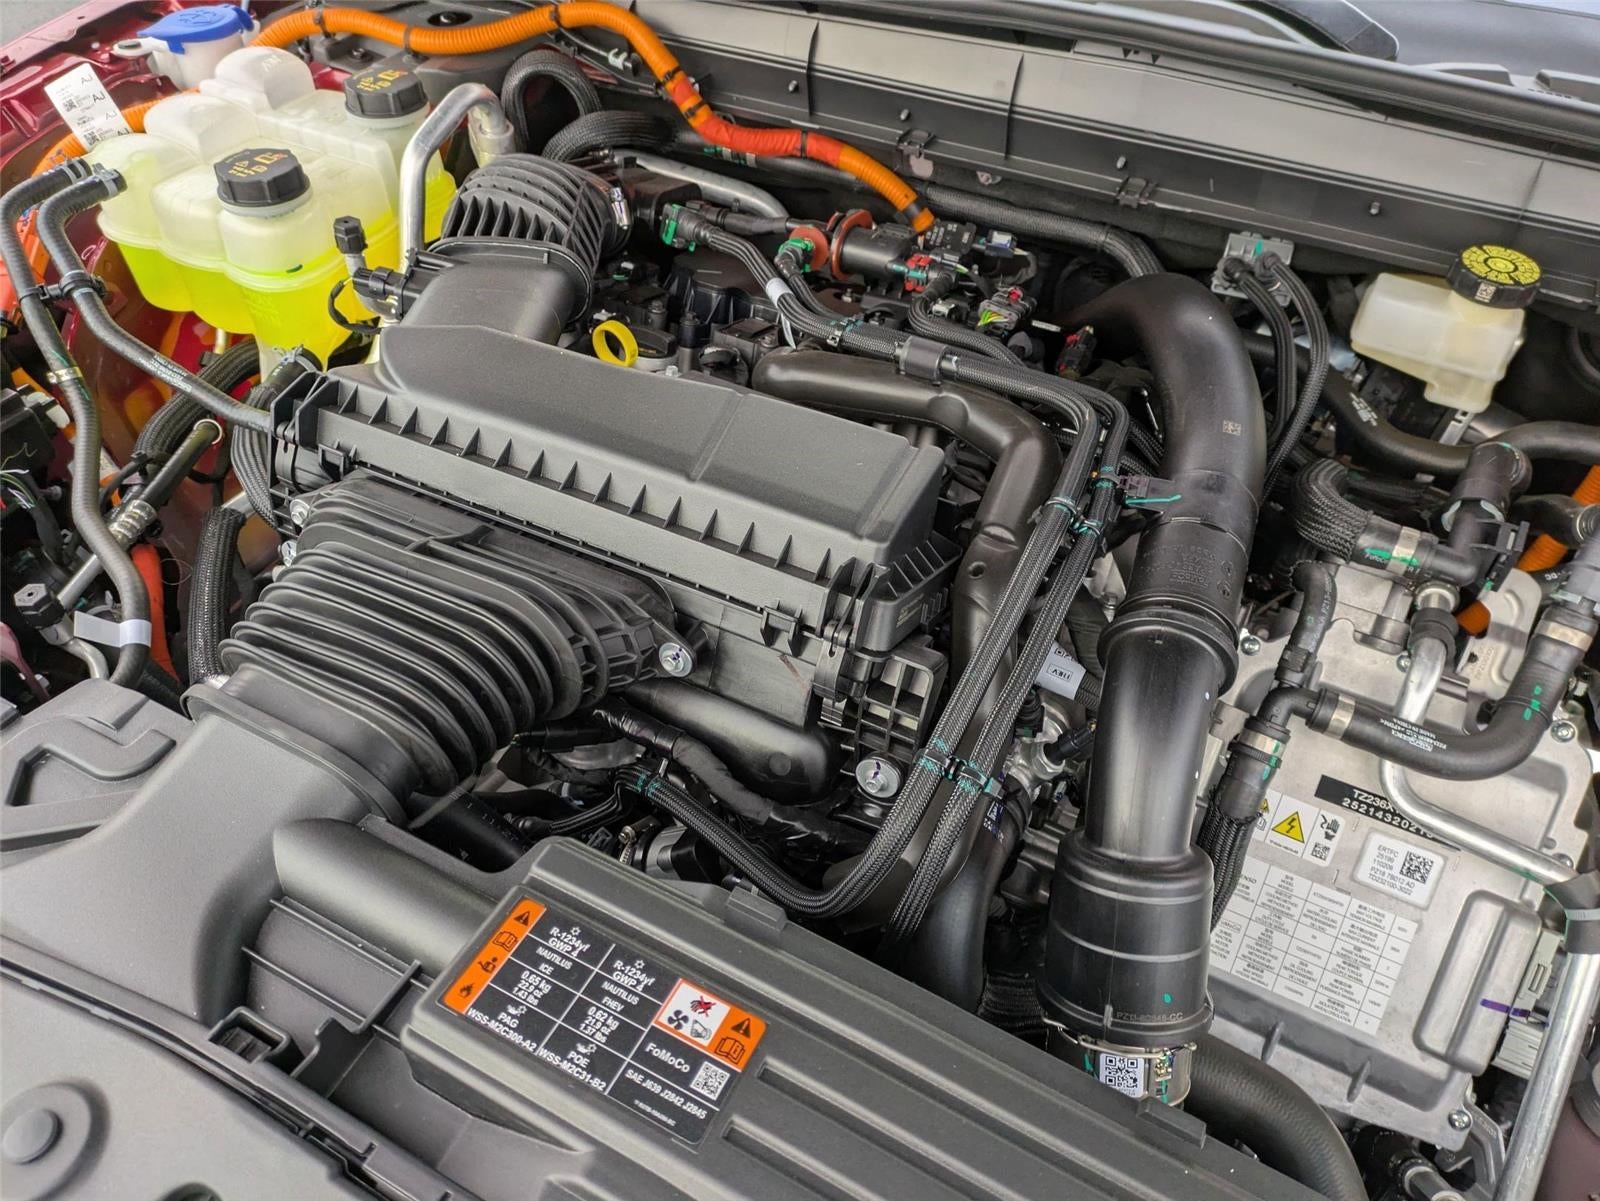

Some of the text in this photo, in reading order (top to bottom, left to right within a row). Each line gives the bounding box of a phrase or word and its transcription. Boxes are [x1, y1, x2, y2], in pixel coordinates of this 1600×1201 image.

[92, 91, 106, 104] AJ
[547, 936, 580, 957] GWP 4
[548, 926, 590, 954] R-1234yf
[535, 945, 573, 970] NAUTILUS
[537, 962, 554, 975] ICE
[520, 969, 553, 994] 0.65 kg
[611, 970, 645, 992] GWP 4
[612, 959, 655, 987] R-1234yf
[532, 988, 544, 998] oz
[600, 980, 640, 1006] NAUTILUS
[601, 996, 624, 1013] FHEV
[496, 1011, 520, 1029] PAG
[586, 1005, 620, 1031] 0.62 kg
[465, 1007, 538, 1052] WSS-M2C300-A2
[598, 1025, 611, 1035] oz
[566, 1050, 591, 1068] POE
[644, 1041, 692, 1073] FoMoCo
[536, 1047, 607, 1091] WSS-M2C31-B2
[624, 1068, 645, 1084] SAE
